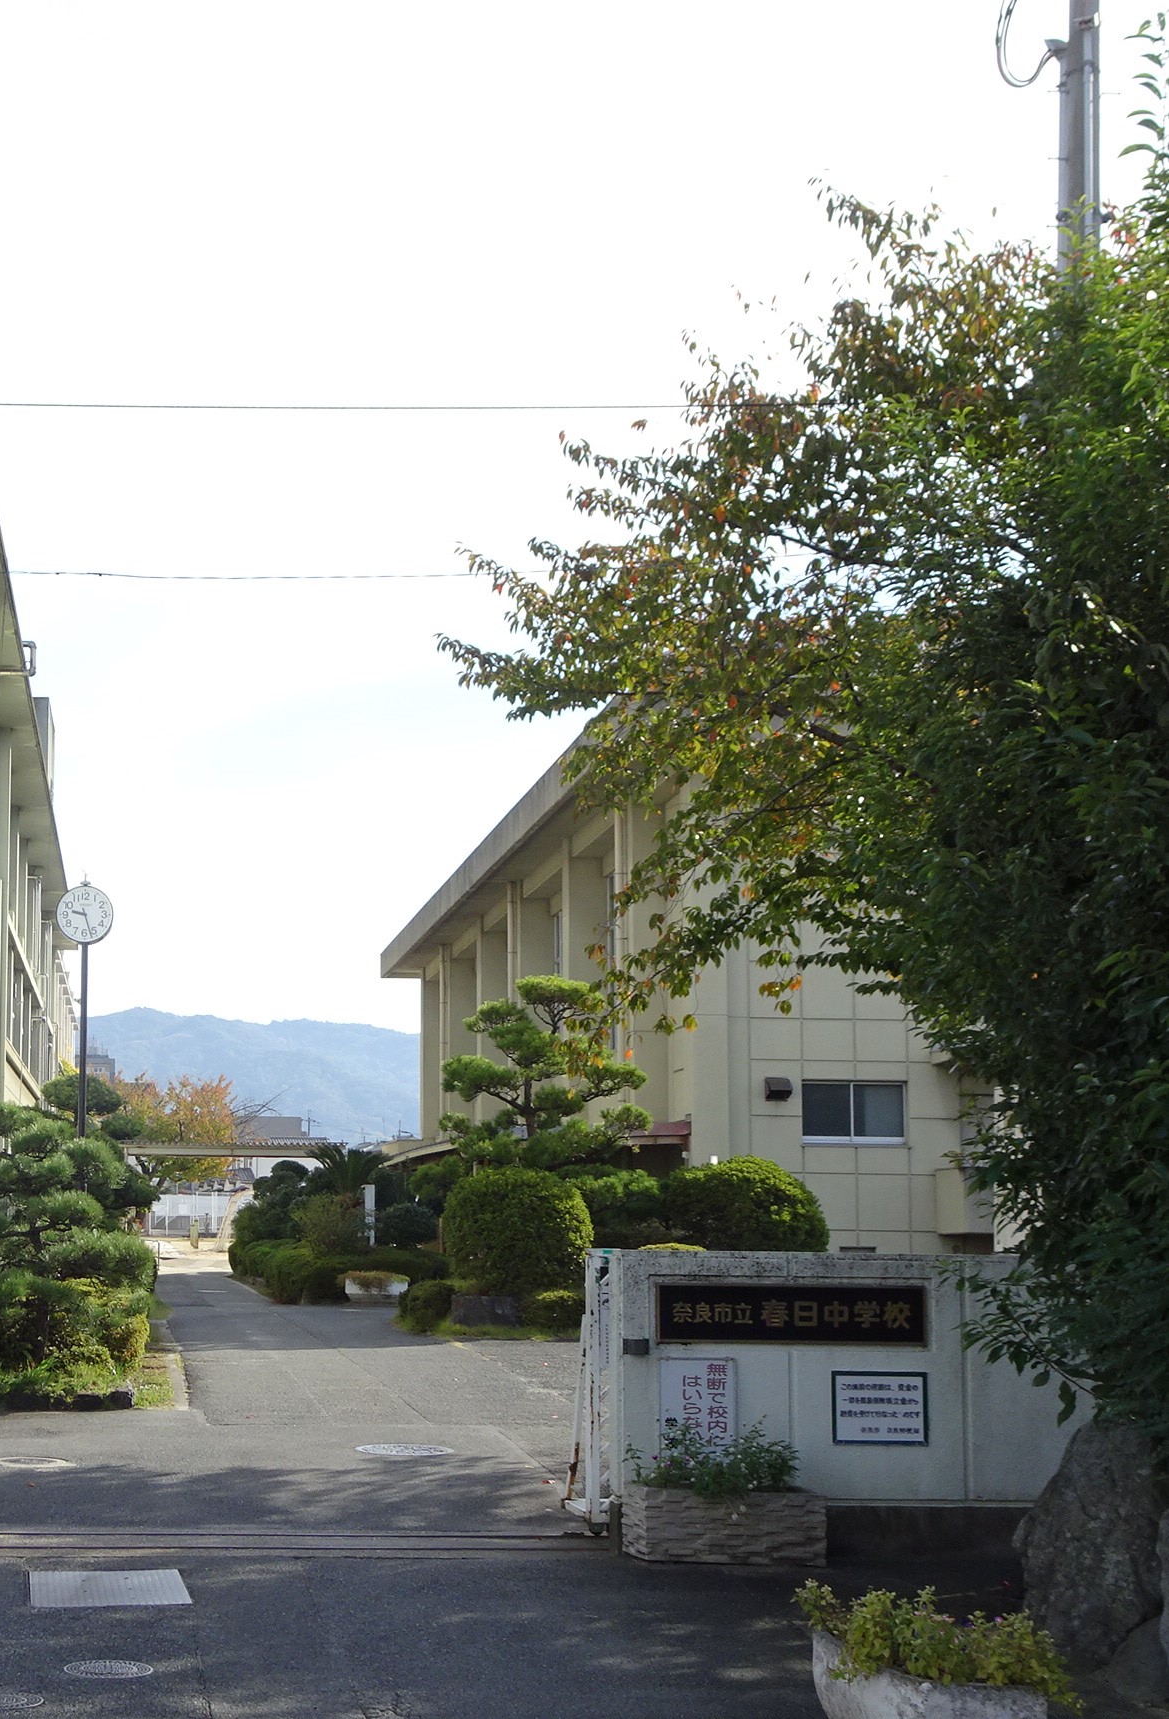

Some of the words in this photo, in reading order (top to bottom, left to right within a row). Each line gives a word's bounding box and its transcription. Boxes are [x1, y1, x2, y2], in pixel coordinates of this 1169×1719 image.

[81, 891, 90, 901] 12
[98, 900, 105, 909] 2
[62, 910, 69, 919] 9
[101, 910, 108, 919] 3
[65, 919, 72, 928] 8
[98, 919, 104, 928] 4
[73, 926, 79, 935] 7
[81, 928, 88, 937] 6
[91, 926, 97, 935] 5
[672, 1301, 754, 1325] 奈良市立
[760, 1299, 912, 1329] 春日中学校
